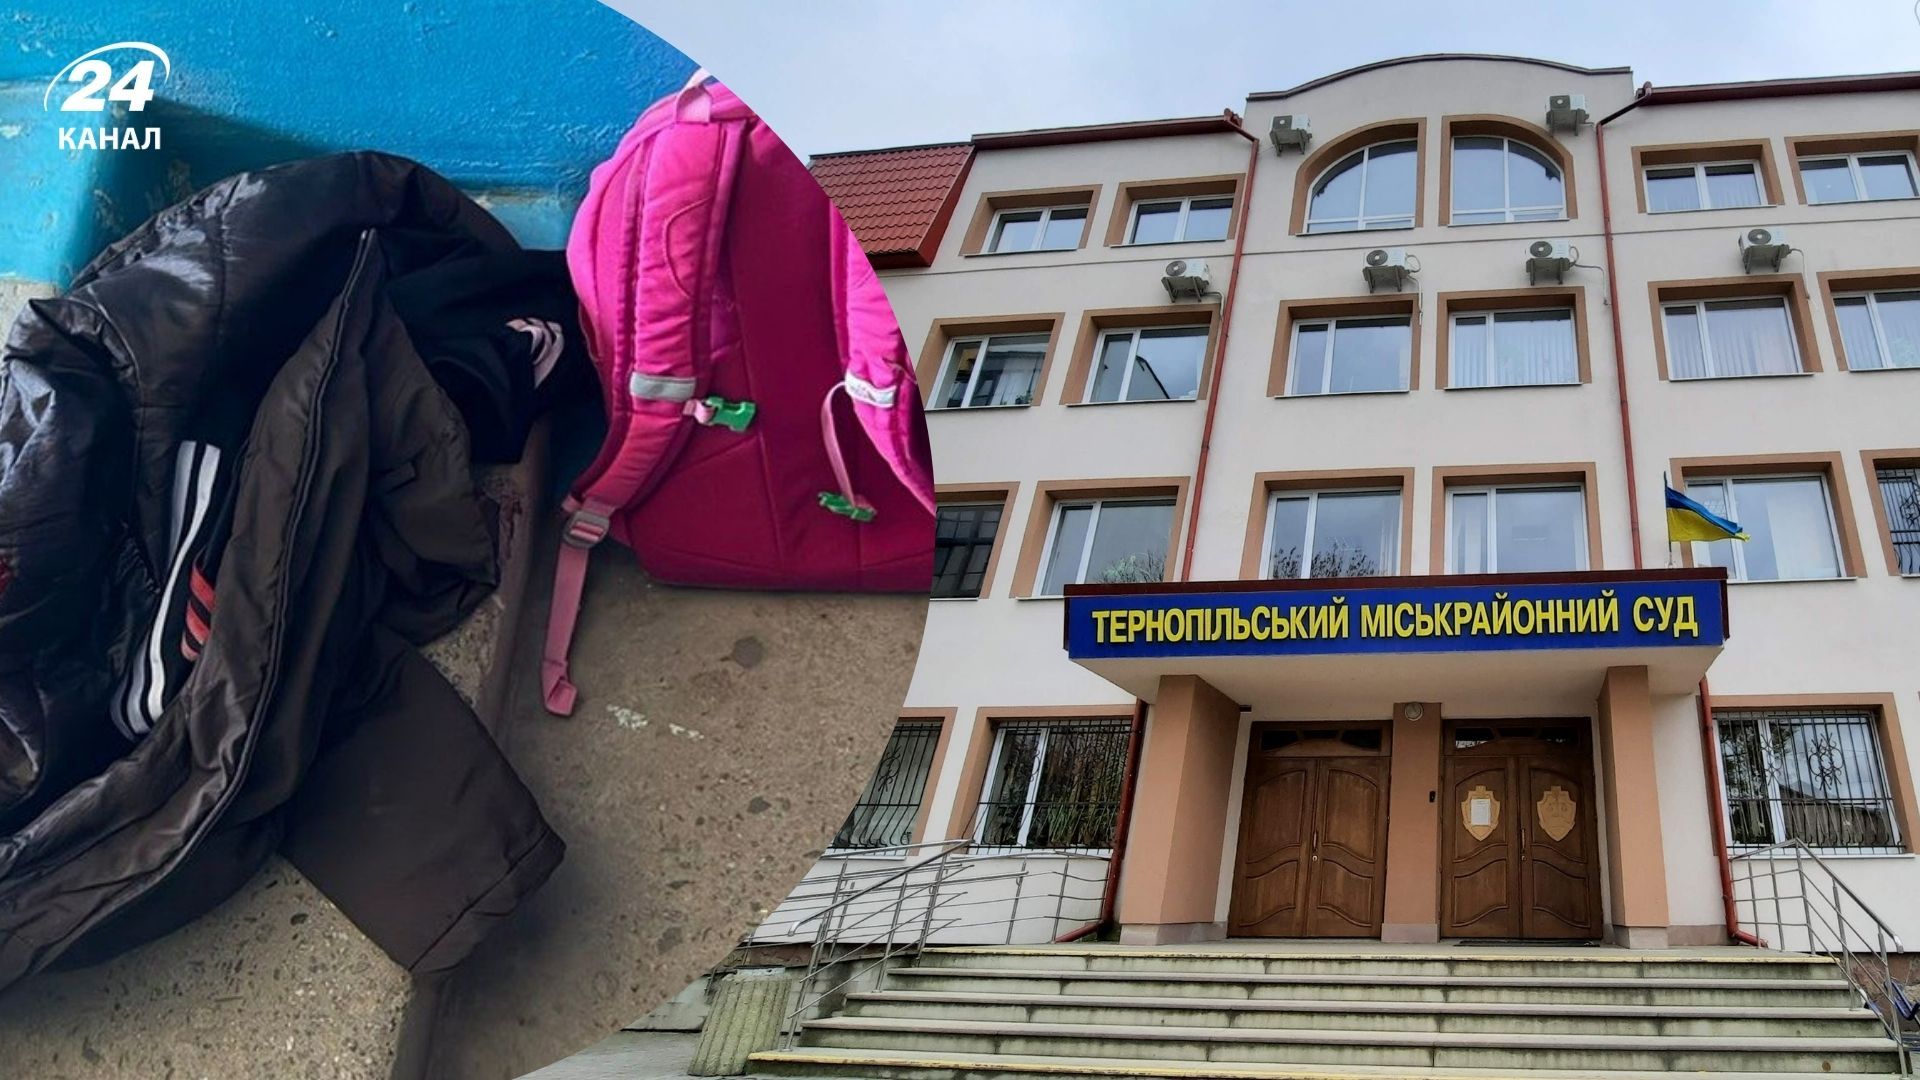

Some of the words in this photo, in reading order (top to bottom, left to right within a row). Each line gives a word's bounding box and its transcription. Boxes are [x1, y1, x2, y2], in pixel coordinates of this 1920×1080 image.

[1092, 595, 1349, 643] ТЕРНОПІЛЬСЬКИЙ
[1361, 590, 1619, 638] МІСЬКРАЙОННИЙ
[1633, 596, 1699, 637] СУД
